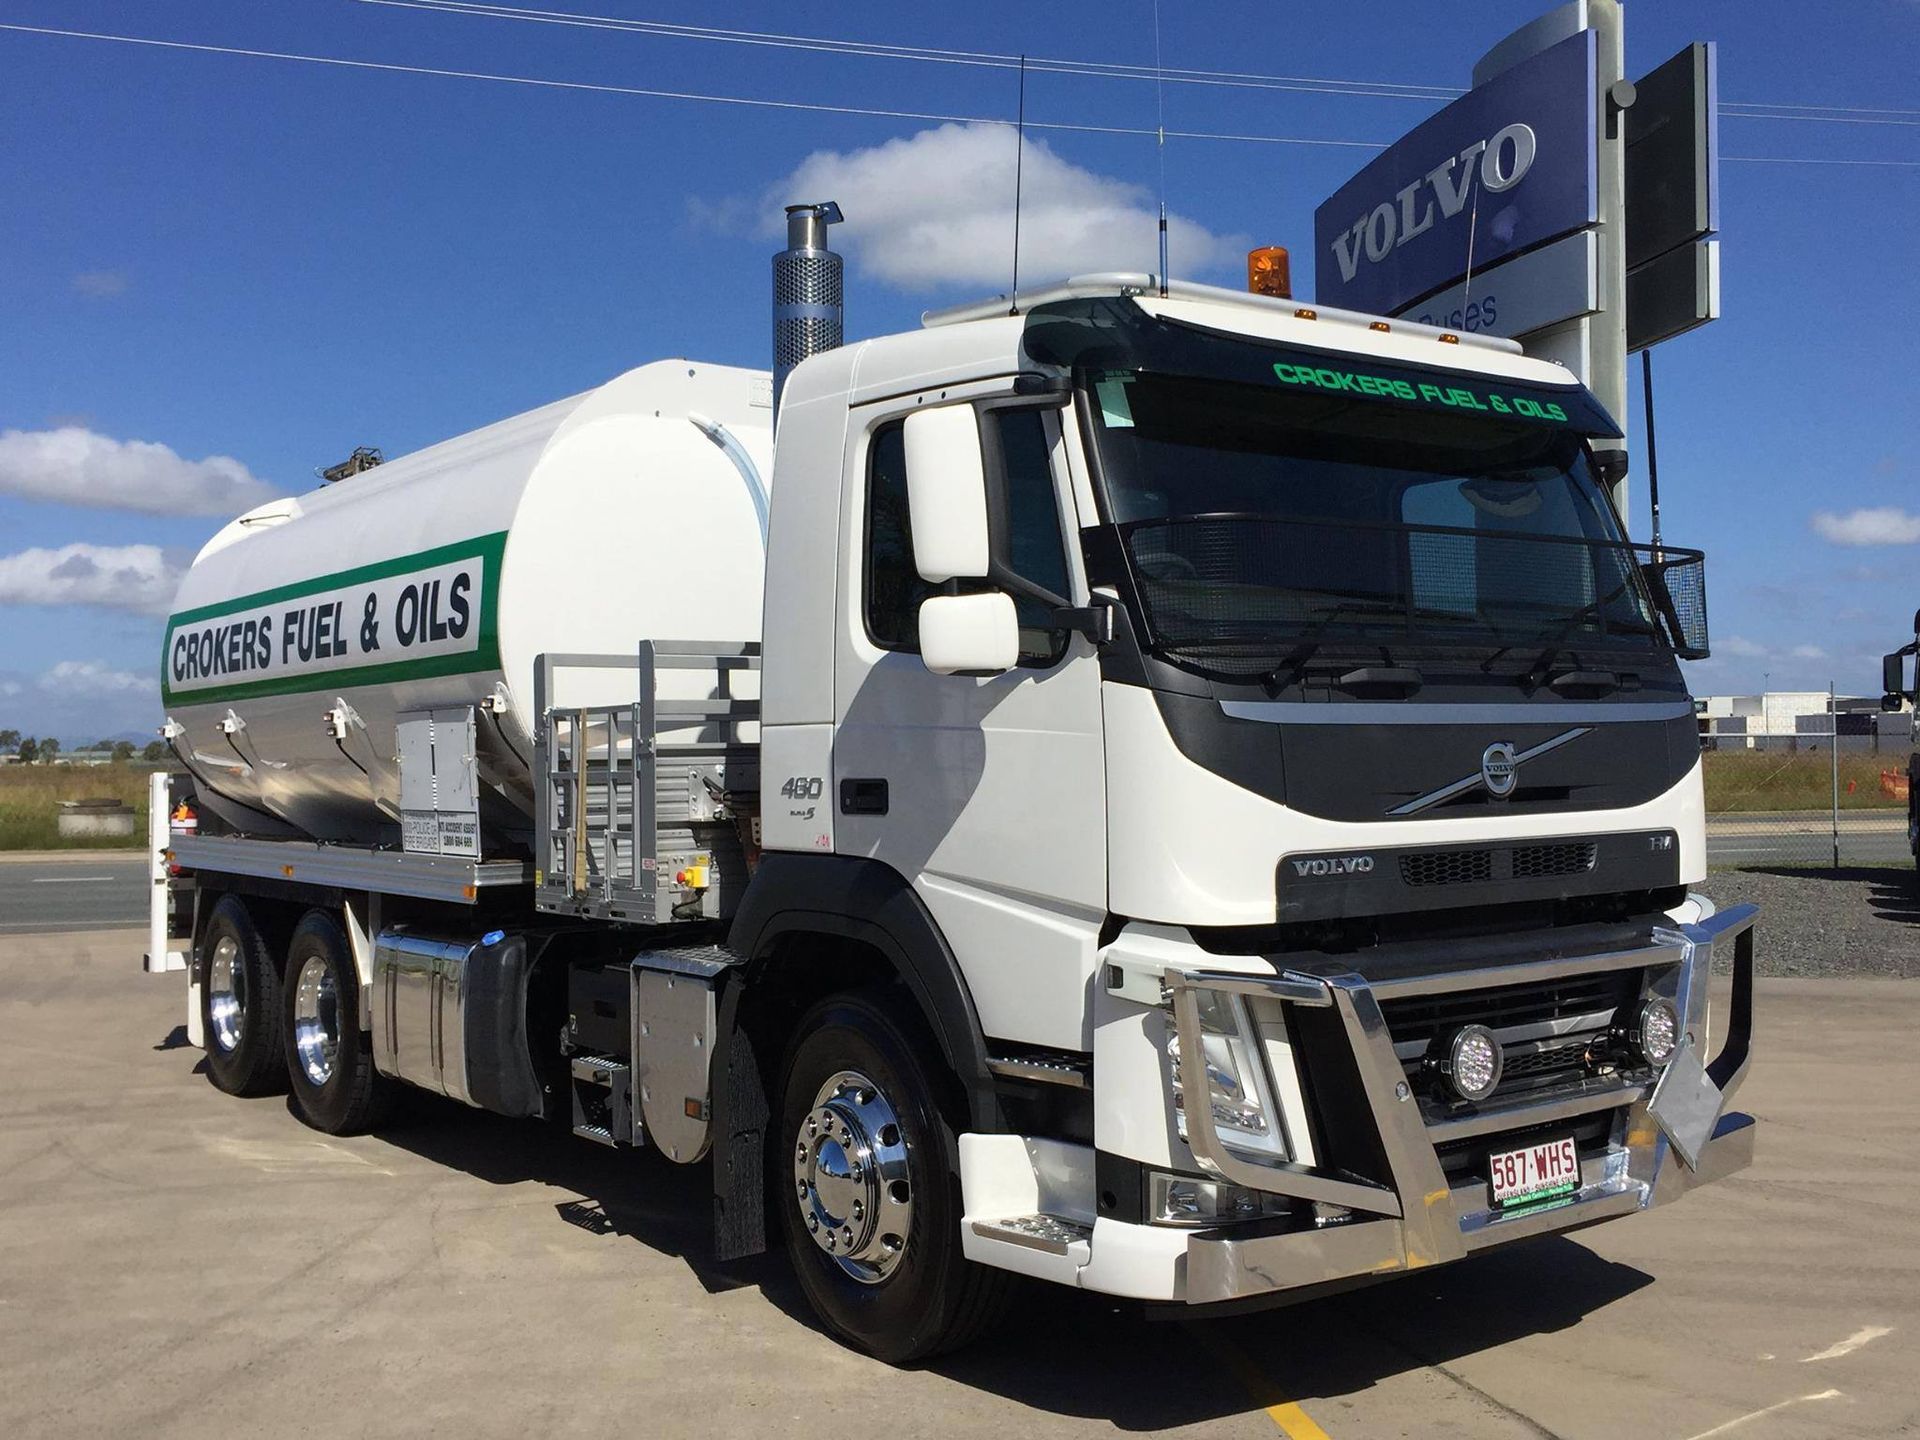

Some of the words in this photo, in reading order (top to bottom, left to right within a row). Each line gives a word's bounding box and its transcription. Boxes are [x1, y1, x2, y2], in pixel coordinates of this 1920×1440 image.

[1330, 122, 1537, 285] VOLVO
[1272, 362, 1417, 400] CROKERS
[1418, 384, 1488, 410] FUEL
[1489, 394, 1512, 413] &
[1512, 398, 1568, 422] OILS
[172, 615, 272, 683] CROKERS
[282, 601, 348, 665] FUEL
[360, 591, 380, 653] &
[395, 572, 471, 647] OILS
[1485, 764, 1514, 772] VOLVO
[1291, 855, 1375, 877] VOLVO
[1496, 1187, 1530, 1200] QUEENSLAND
[1534, 1179, 1559, 1192] SUNSHINE
[1561, 1174, 1576, 1184] STATE
